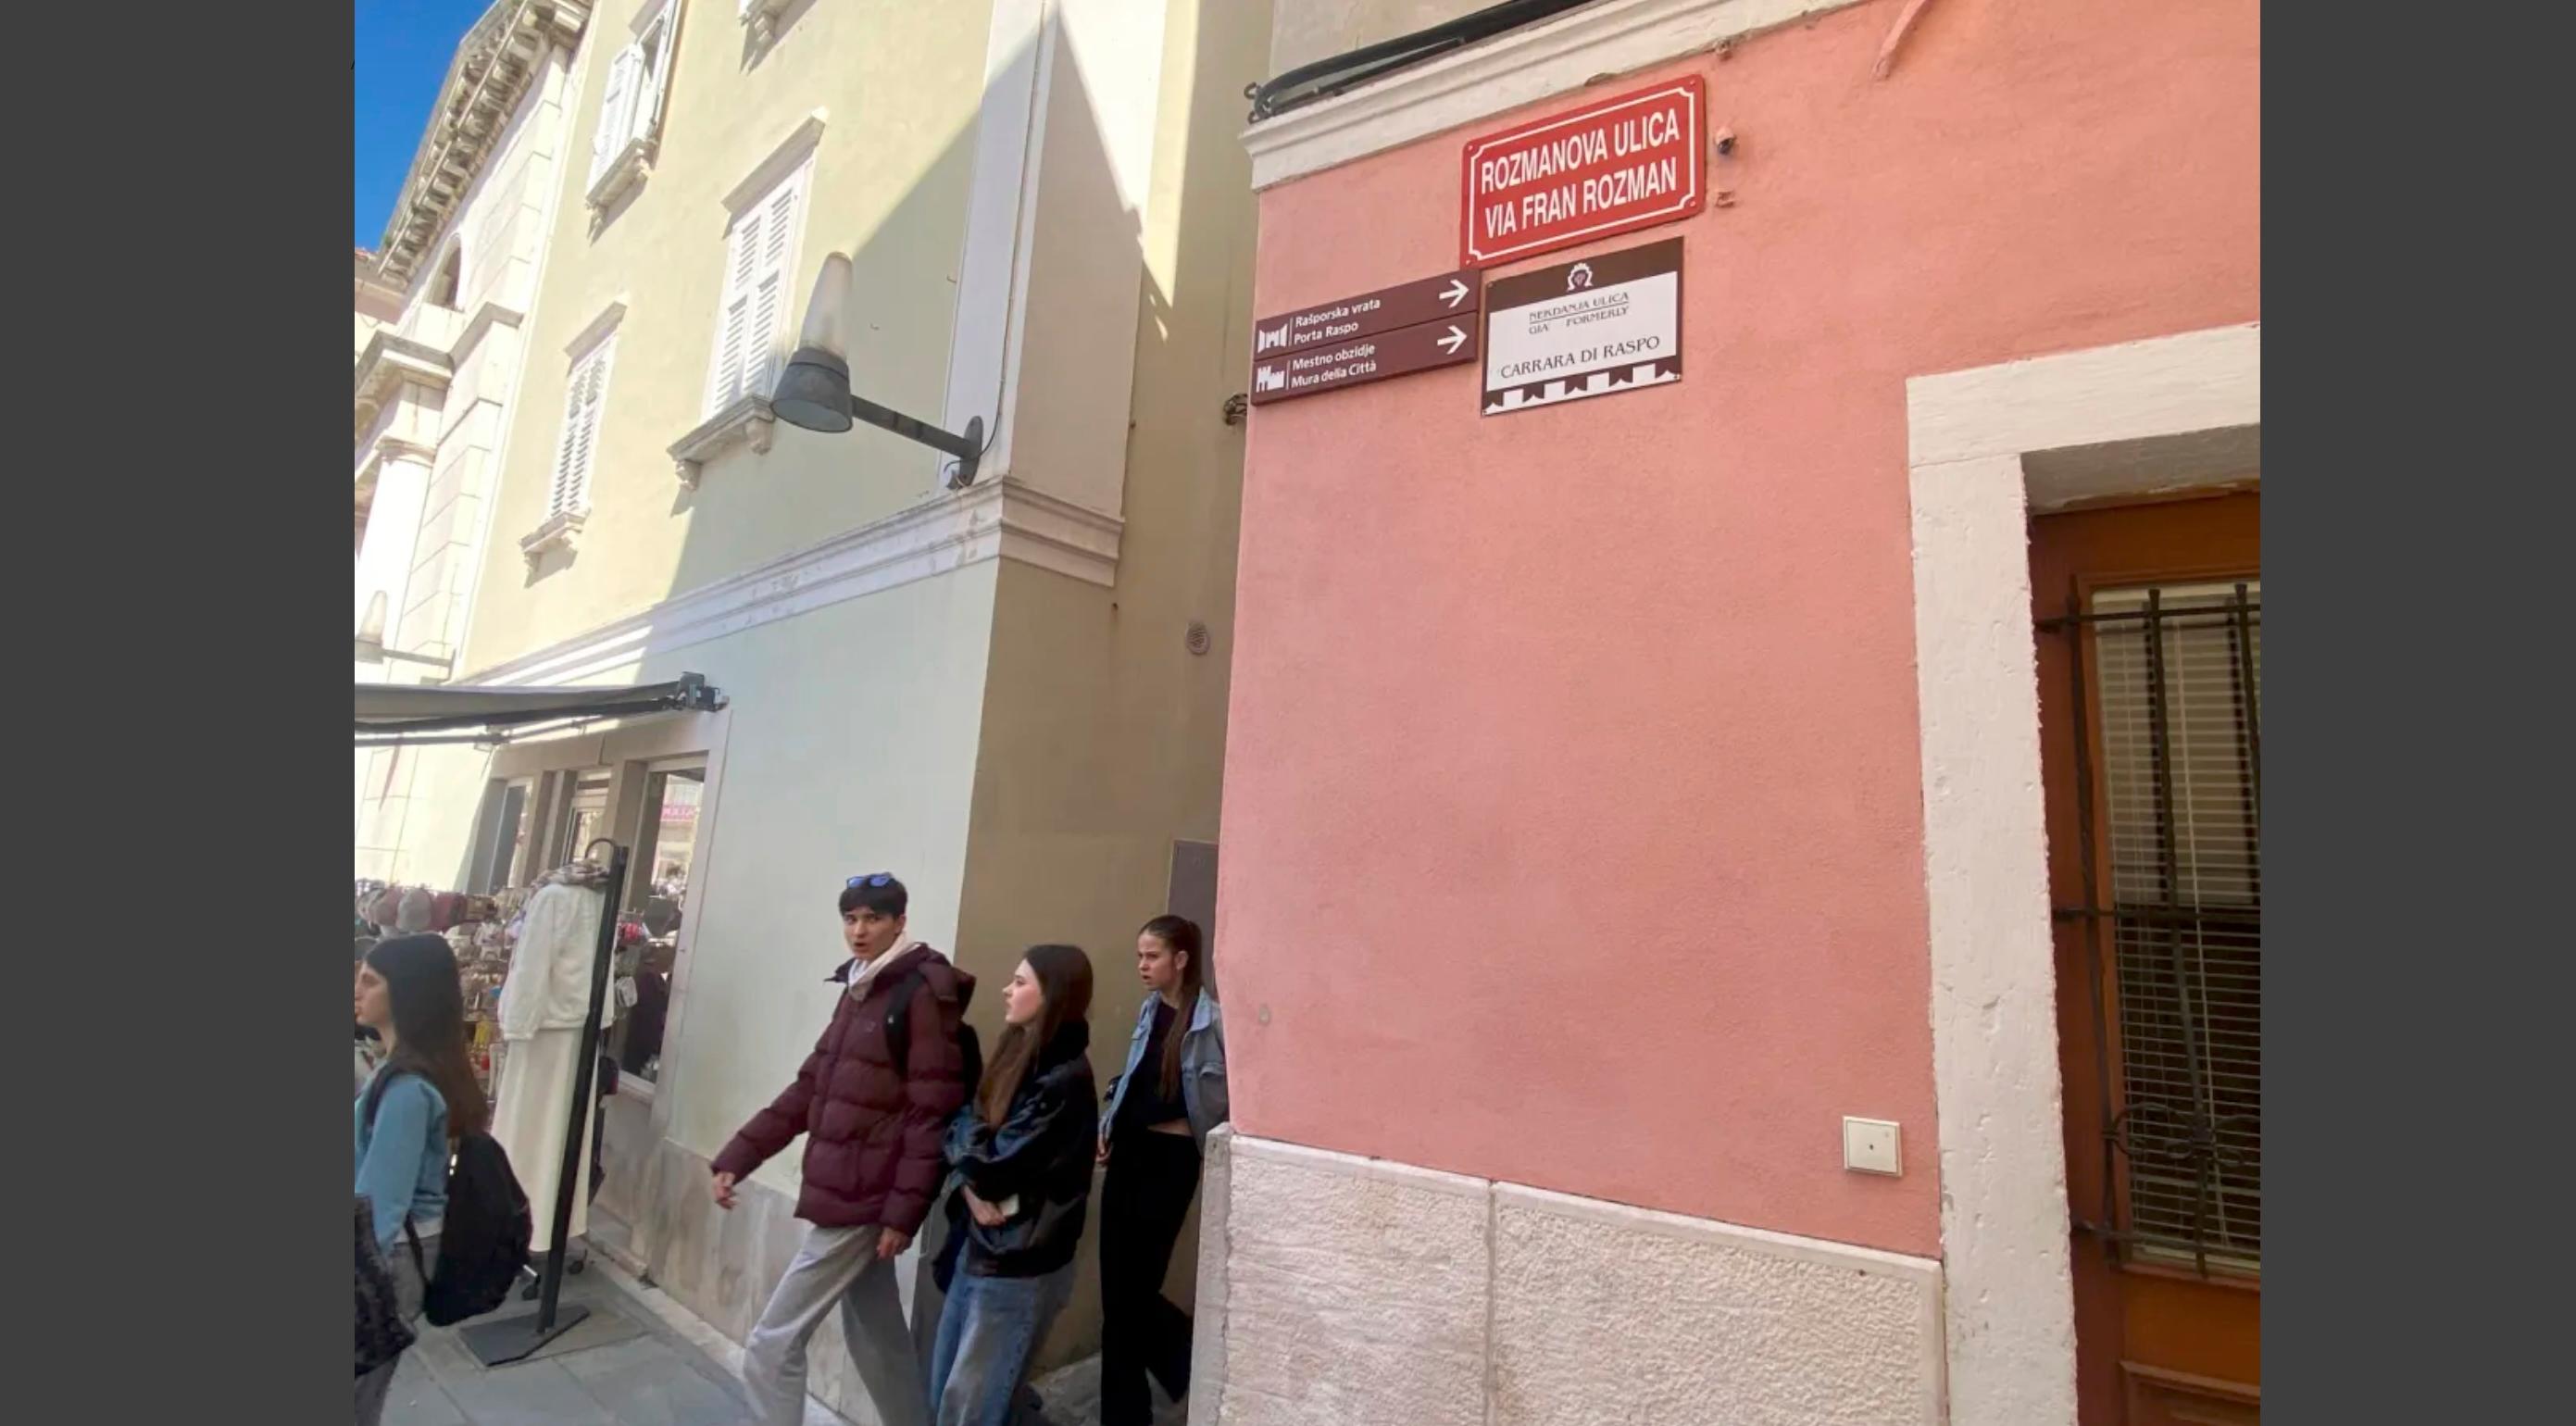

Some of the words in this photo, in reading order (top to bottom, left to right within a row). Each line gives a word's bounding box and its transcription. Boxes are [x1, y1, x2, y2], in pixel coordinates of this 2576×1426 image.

[1482, 129, 1607, 194] ROZMANOVA
[1614, 108, 1680, 156] ULICA
[1485, 201, 1517, 239] VIA
[1522, 183, 1576, 230] FRAN
[1582, 156, 1677, 214] ROZMAN
[1295, 306, 1349, 328] Rašporska
[1351, 299, 1381, 314] vrata
[1529, 300, 1590, 321] NEKDANJA
[1593, 292, 1629, 306] ULICA
[1566, 306, 1630, 327] FORMERLY
[1294, 330, 1322, 345] Porta
[1325, 321, 1359, 337] Raspo
[1293, 354, 1333, 371] Mestno
[1334, 344, 1375, 362] obzidje
[1500, 352, 1575, 379] CARRARA
[1581, 347, 1597, 363] DI
[1603, 335, 1660, 358] RASPO
[1291, 374, 1319, 389] Mura
[1320, 368, 1347, 382] della
[1348, 359, 1377, 376] Città
